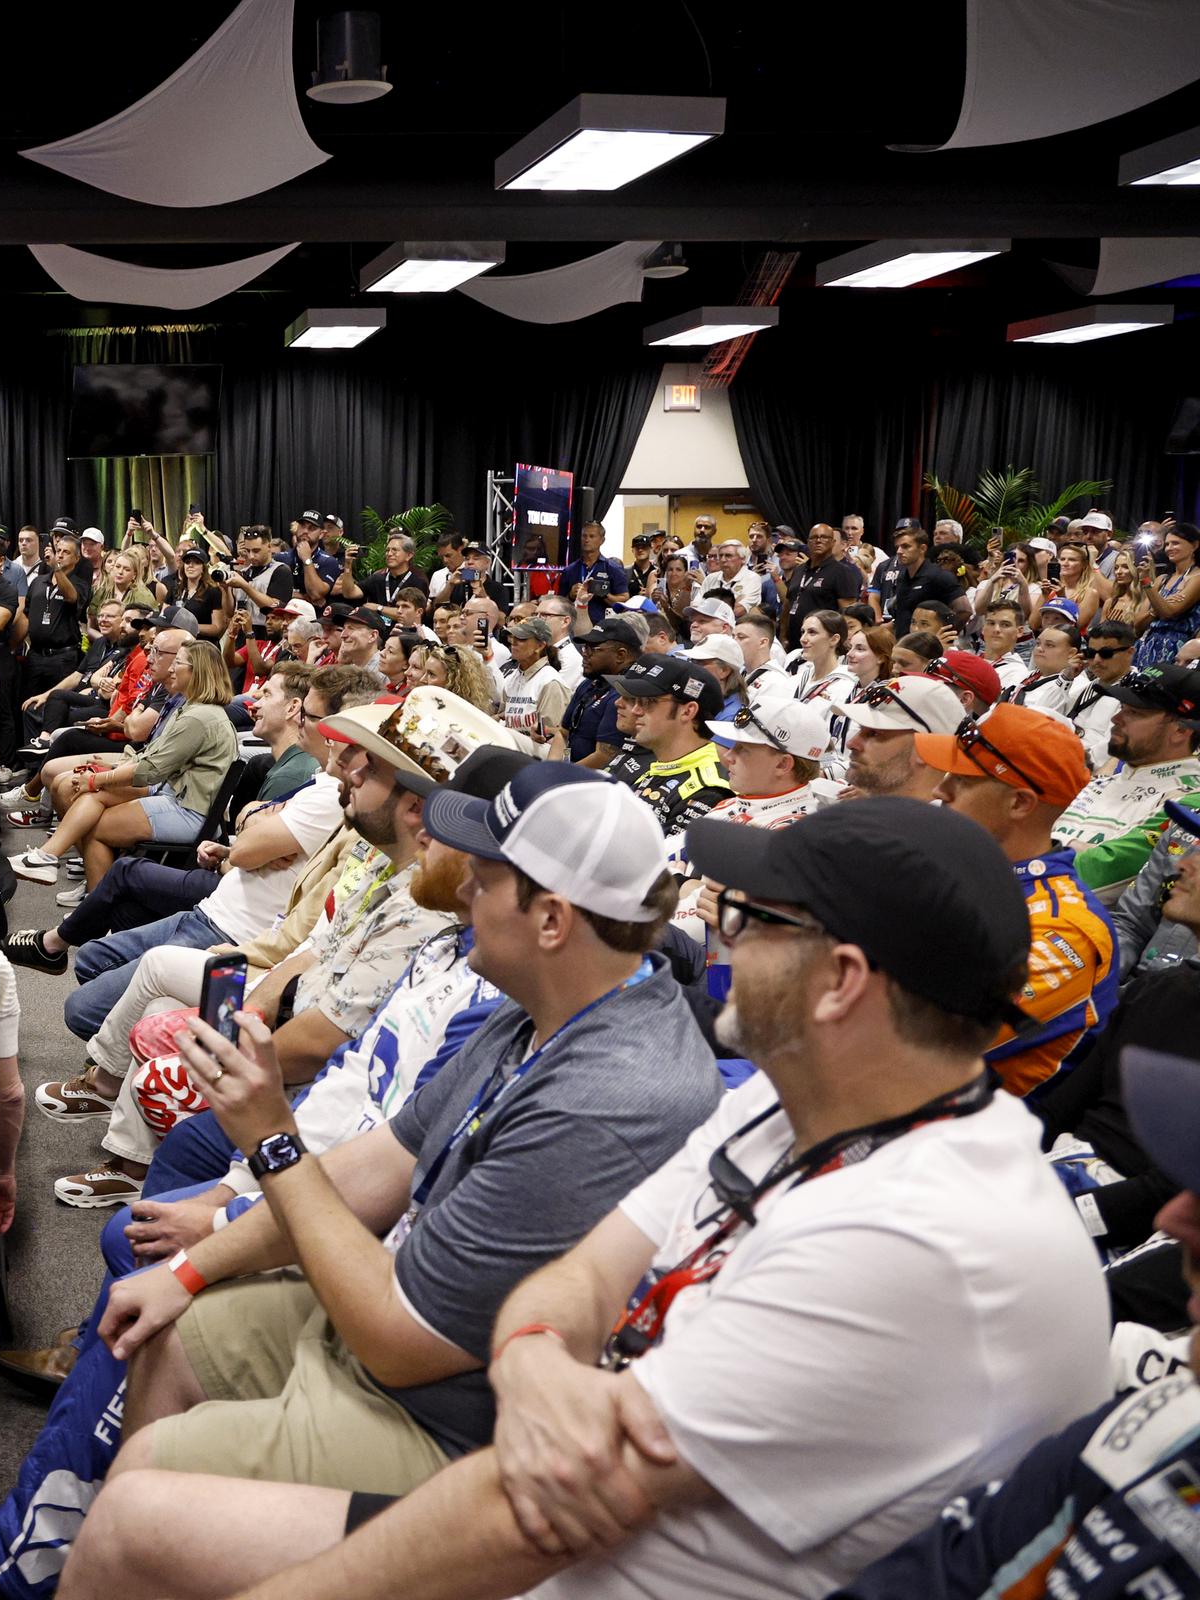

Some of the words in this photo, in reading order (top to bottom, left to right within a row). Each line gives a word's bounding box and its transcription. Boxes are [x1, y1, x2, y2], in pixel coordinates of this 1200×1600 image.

[672, 384, 697, 405] EXIT
[1150, 764, 1182, 775] DOLLAR
[1156, 770, 1176, 779] TREE
[1053, 938, 1086, 969] NASCAR
